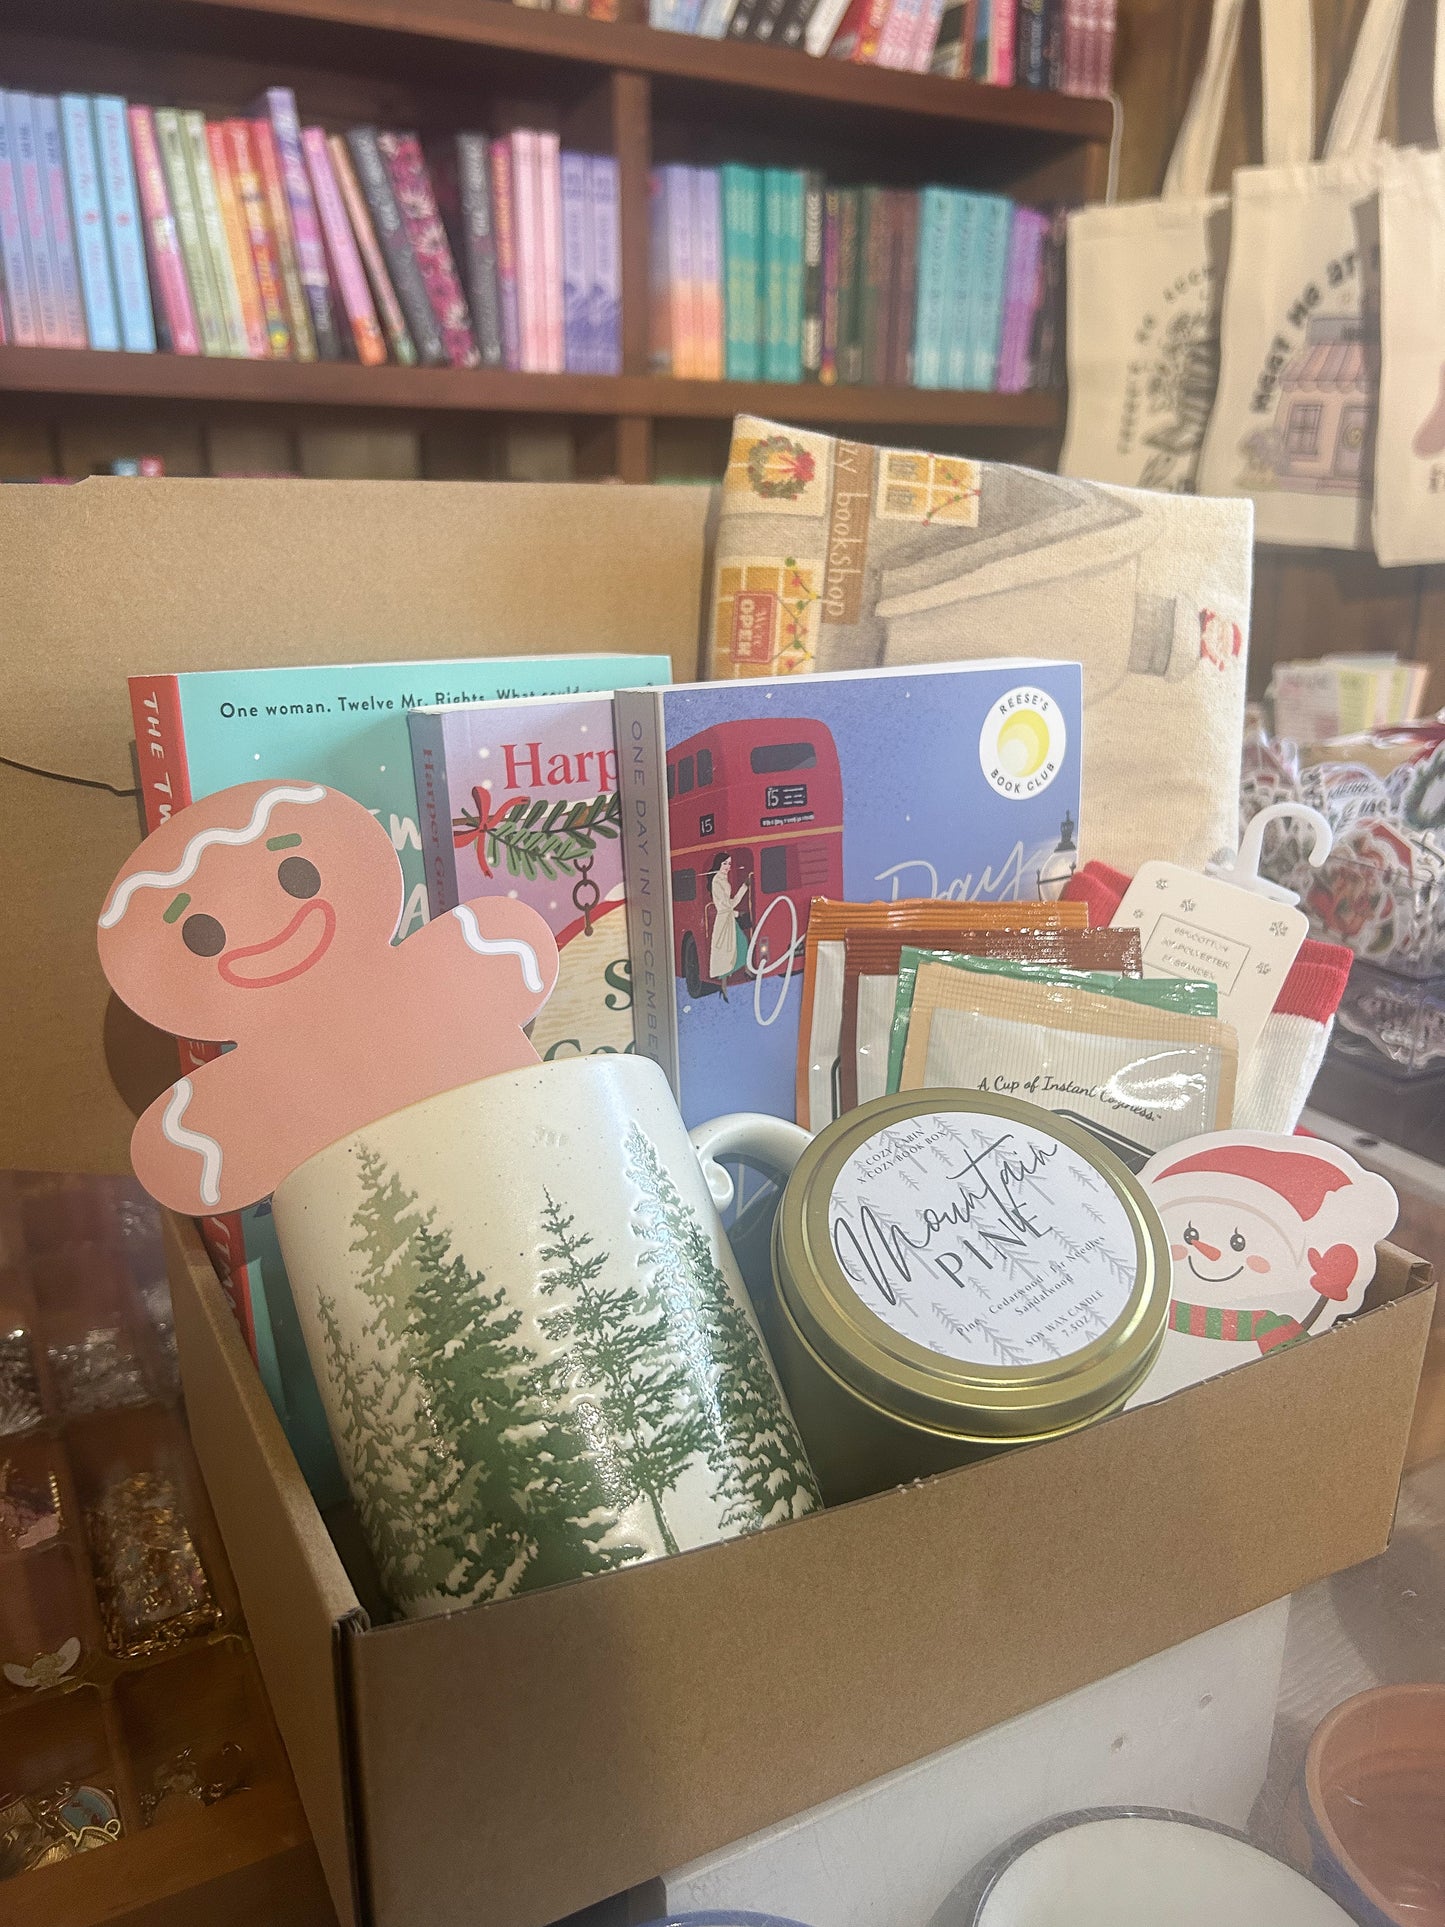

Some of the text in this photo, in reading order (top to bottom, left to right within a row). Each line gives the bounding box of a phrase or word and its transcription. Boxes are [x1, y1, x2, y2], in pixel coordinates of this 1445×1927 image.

[219, 701, 258, 718] One
[265, 701, 332, 717] woman.
[338, 695, 394, 712] Twelve
[401, 693, 430, 709] Mr.
[999, 693, 1049, 715] REESE'S
[143, 691, 165, 759] THE
[631, 720, 646, 787] ONE
[767, 787, 780, 807] 15
[990, 762, 1055, 793] BOOK CLUB
[635, 801, 649, 855] DAY
[700, 817, 713, 834] 15
[639, 866, 653, 893] IN
[977, 1077, 990, 1092] A
[994, 1075, 1020, 1093] Cup
[1023, 1076, 1041, 1093] of
[1041, 1076, 1097, 1098] Instant
[865, 1128, 925, 1166] COZY CABIN
[867, 1160, 896, 1179] COZY
[895, 1143, 926, 1162] BOOK
[924, 1130, 949, 1146] BOX
[833, 1134, 1058, 1306] Mountain
[934, 1202, 1053, 1289] PINE
[956, 1317, 982, 1336] Pine
[988, 1274, 1044, 1314] Cedarwood
[1064, 1234, 1106, 1264] Needles
[1014, 1273, 1075, 1316] Sandalwood
[1024, 1289, 1105, 1346] SOY WAX CANDLE
[1061, 1314, 1090, 1337] 7.5OZ
